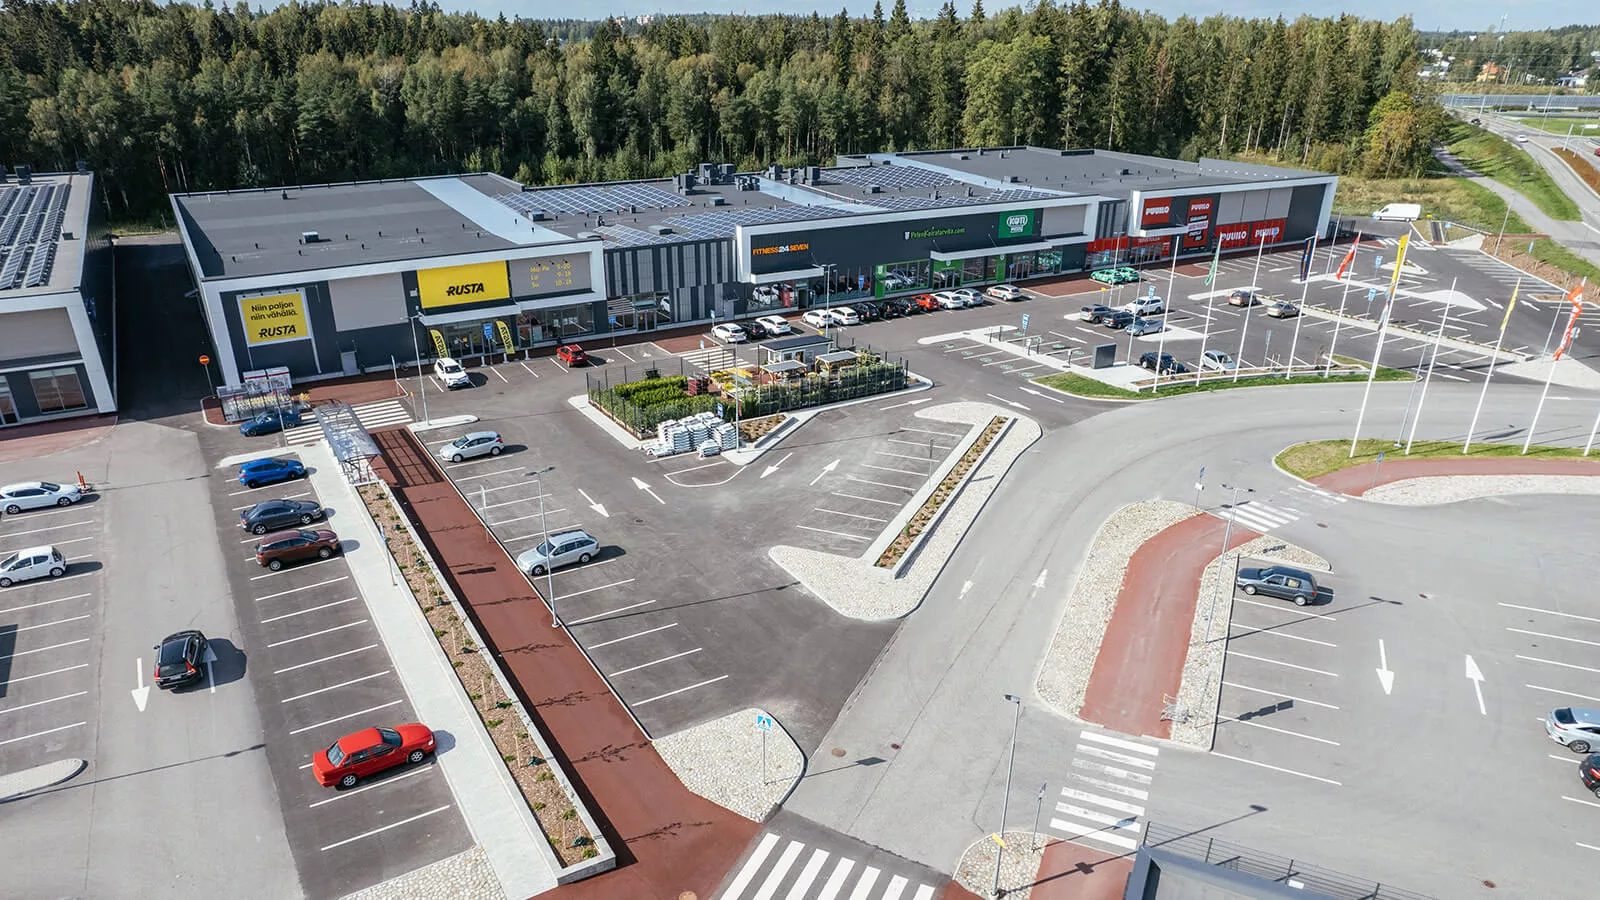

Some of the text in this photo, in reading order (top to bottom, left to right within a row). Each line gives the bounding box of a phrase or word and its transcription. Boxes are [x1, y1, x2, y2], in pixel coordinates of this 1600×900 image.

[1145, 206, 1170, 215] PUUILO
[446, 283, 484, 296] RUSTA
[251, 302, 294, 312] Niin paljon
[250, 313, 266, 321] niin
[259, 325, 296, 338] RUSTA
